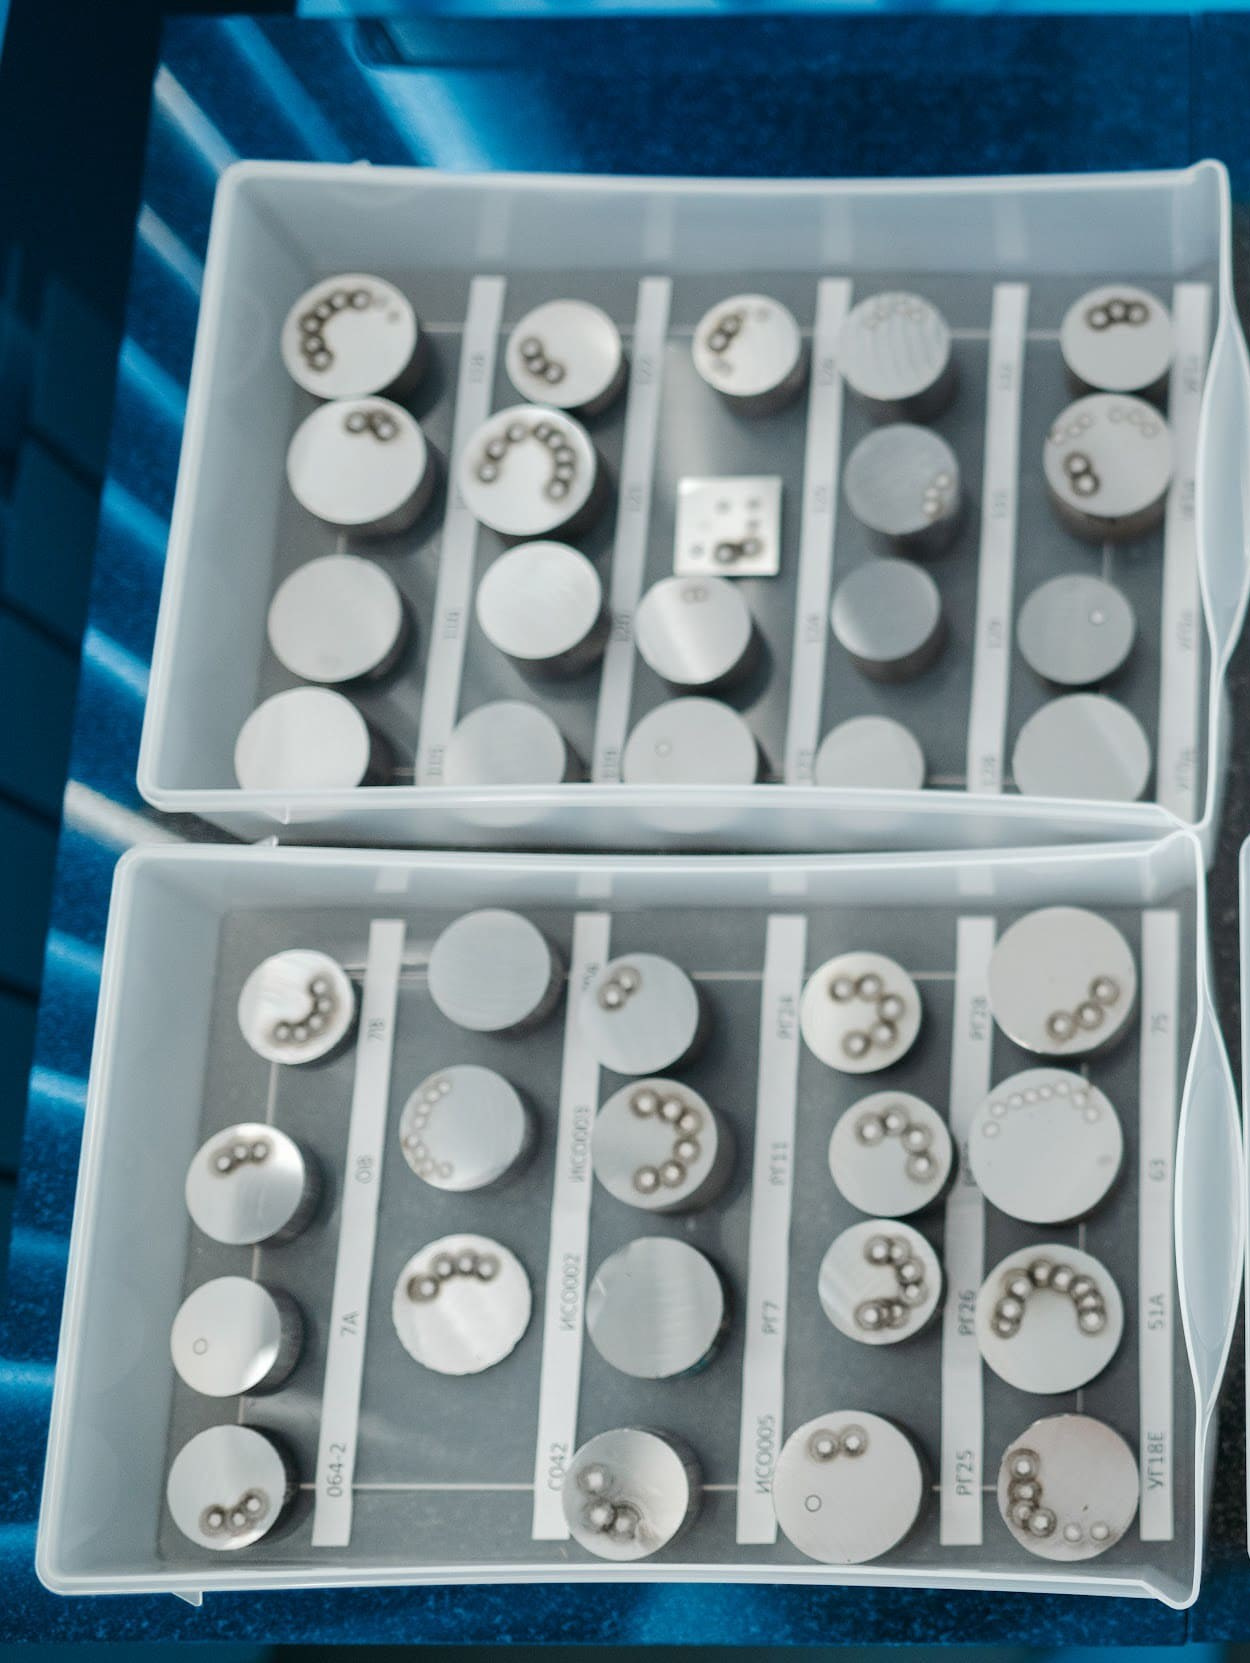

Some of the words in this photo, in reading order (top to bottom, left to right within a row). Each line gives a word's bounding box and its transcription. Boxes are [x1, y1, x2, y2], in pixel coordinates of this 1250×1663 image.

[341, 1310, 358, 1337] 7A
[1148, 1293, 1164, 1330] 51A
[327, 1442, 346, 1497] 064-2
[956, 1449, 973, 1496] РГ25
[1147, 1430, 1164, 1490] УГ18Е
